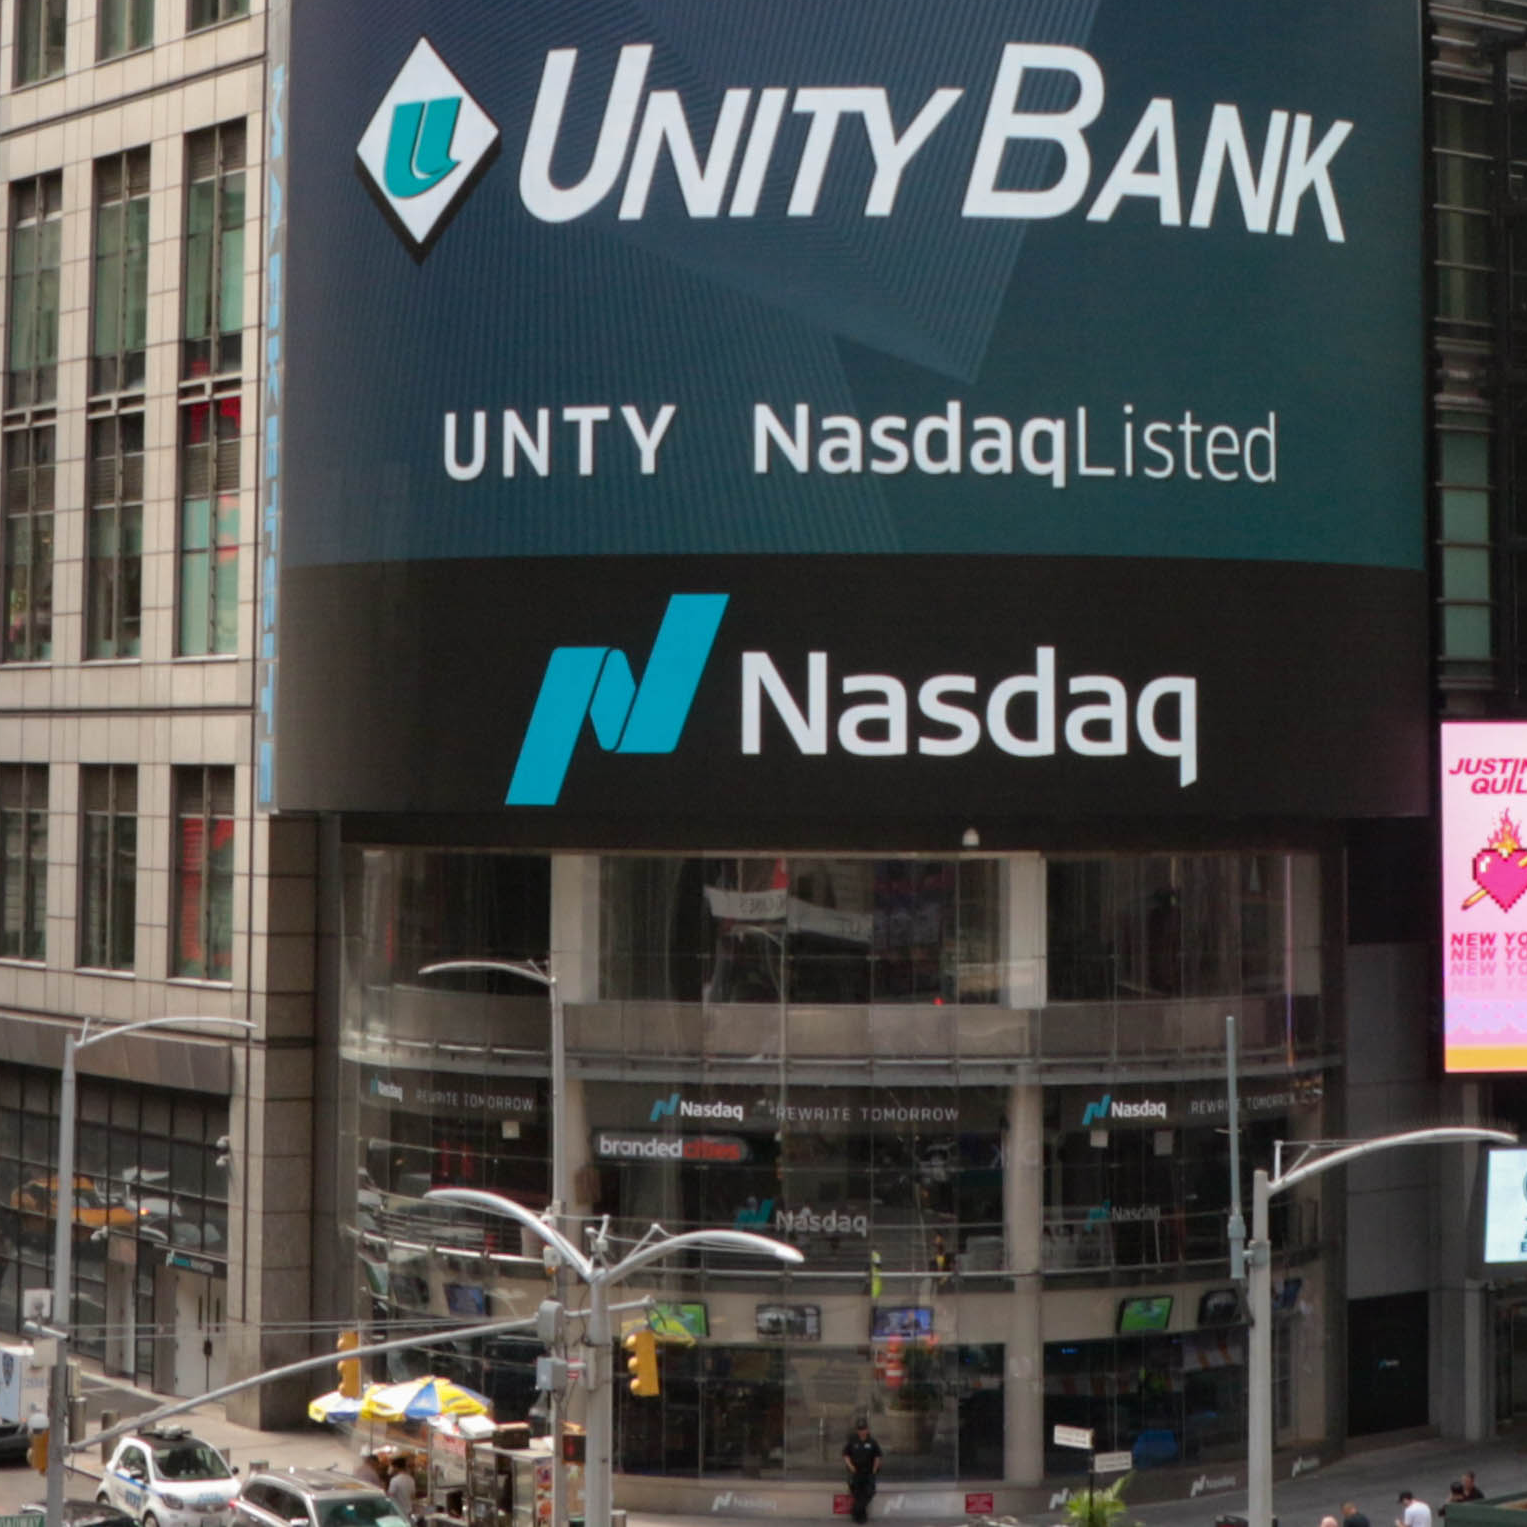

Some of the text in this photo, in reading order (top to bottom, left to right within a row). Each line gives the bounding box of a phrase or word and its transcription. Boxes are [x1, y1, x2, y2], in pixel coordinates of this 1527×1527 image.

[442, 403, 677, 481] UNTY
[741, 646, 1199, 789] Nasdaq
[1450, 932, 1497, 946] NEW
[1450, 946, 1497, 961] NEW
[1450, 961, 1497, 976] NEW
[464, 1093, 534, 1112] TOMORROW
[680, 1101, 744, 1122] Nasdaq
[1111, 1100, 1167, 1119] Nasdaq
[776, 1107, 959, 1122] REWRITE TOMORROW
[775, 1209, 867, 1237] Nasdaq
